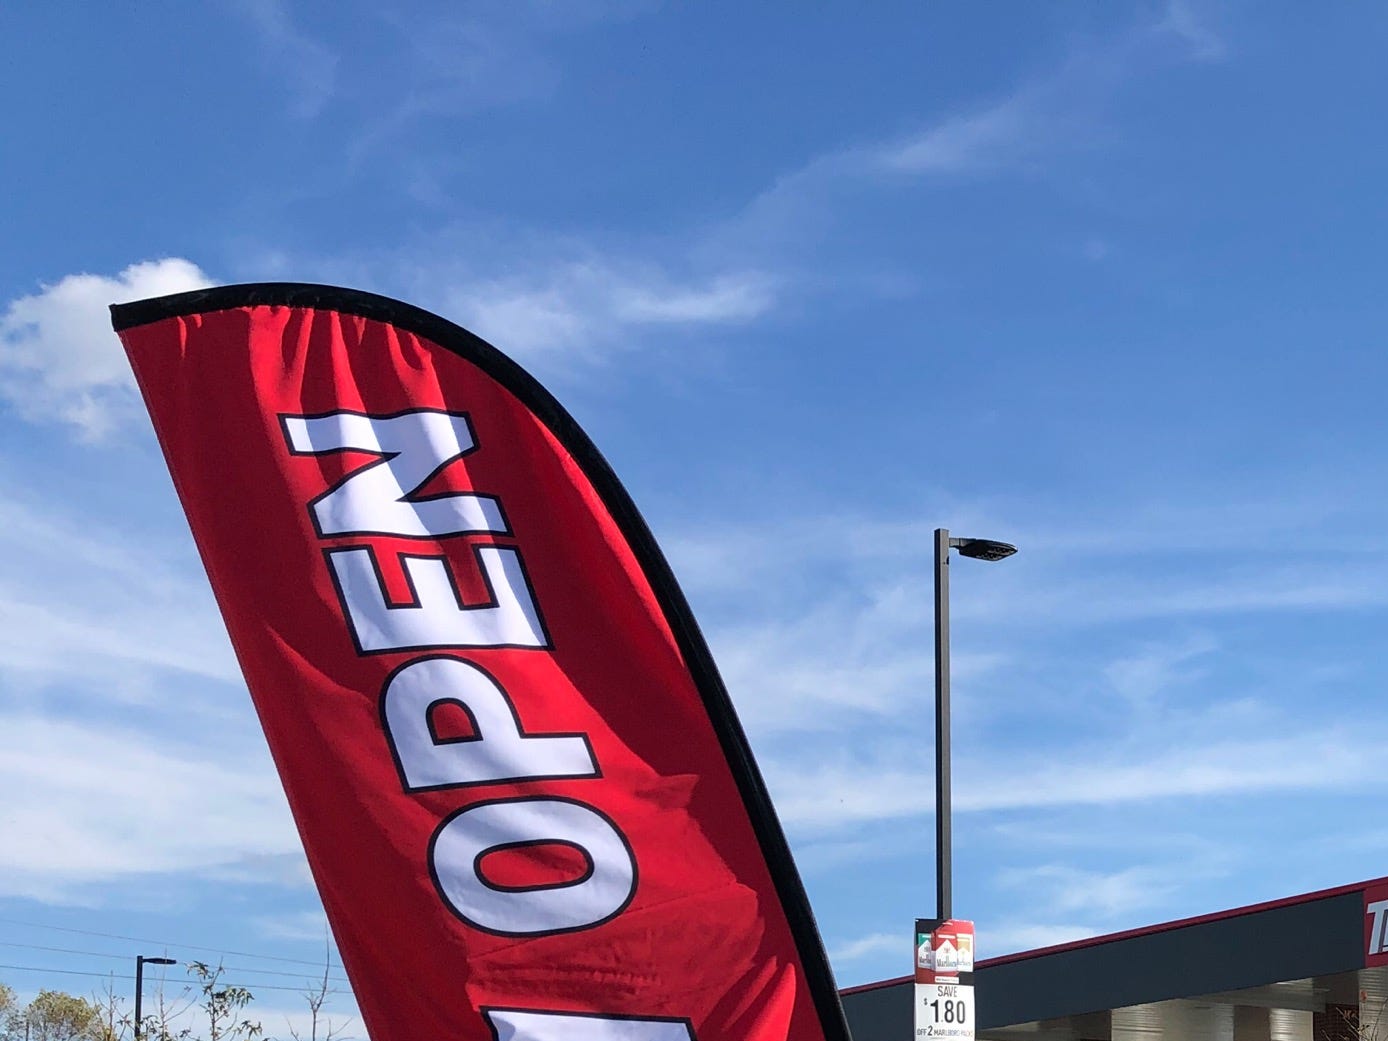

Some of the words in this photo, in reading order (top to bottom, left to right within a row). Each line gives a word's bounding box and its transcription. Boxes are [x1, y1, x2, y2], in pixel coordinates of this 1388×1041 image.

[276, 408, 640, 940] OPEN
[937, 985, 958, 998] SAVE
[923, 998, 966, 1025] $1.80
[916, 1028, 927, 1036] OFF
[927, 1025, 933, 1037] 2
